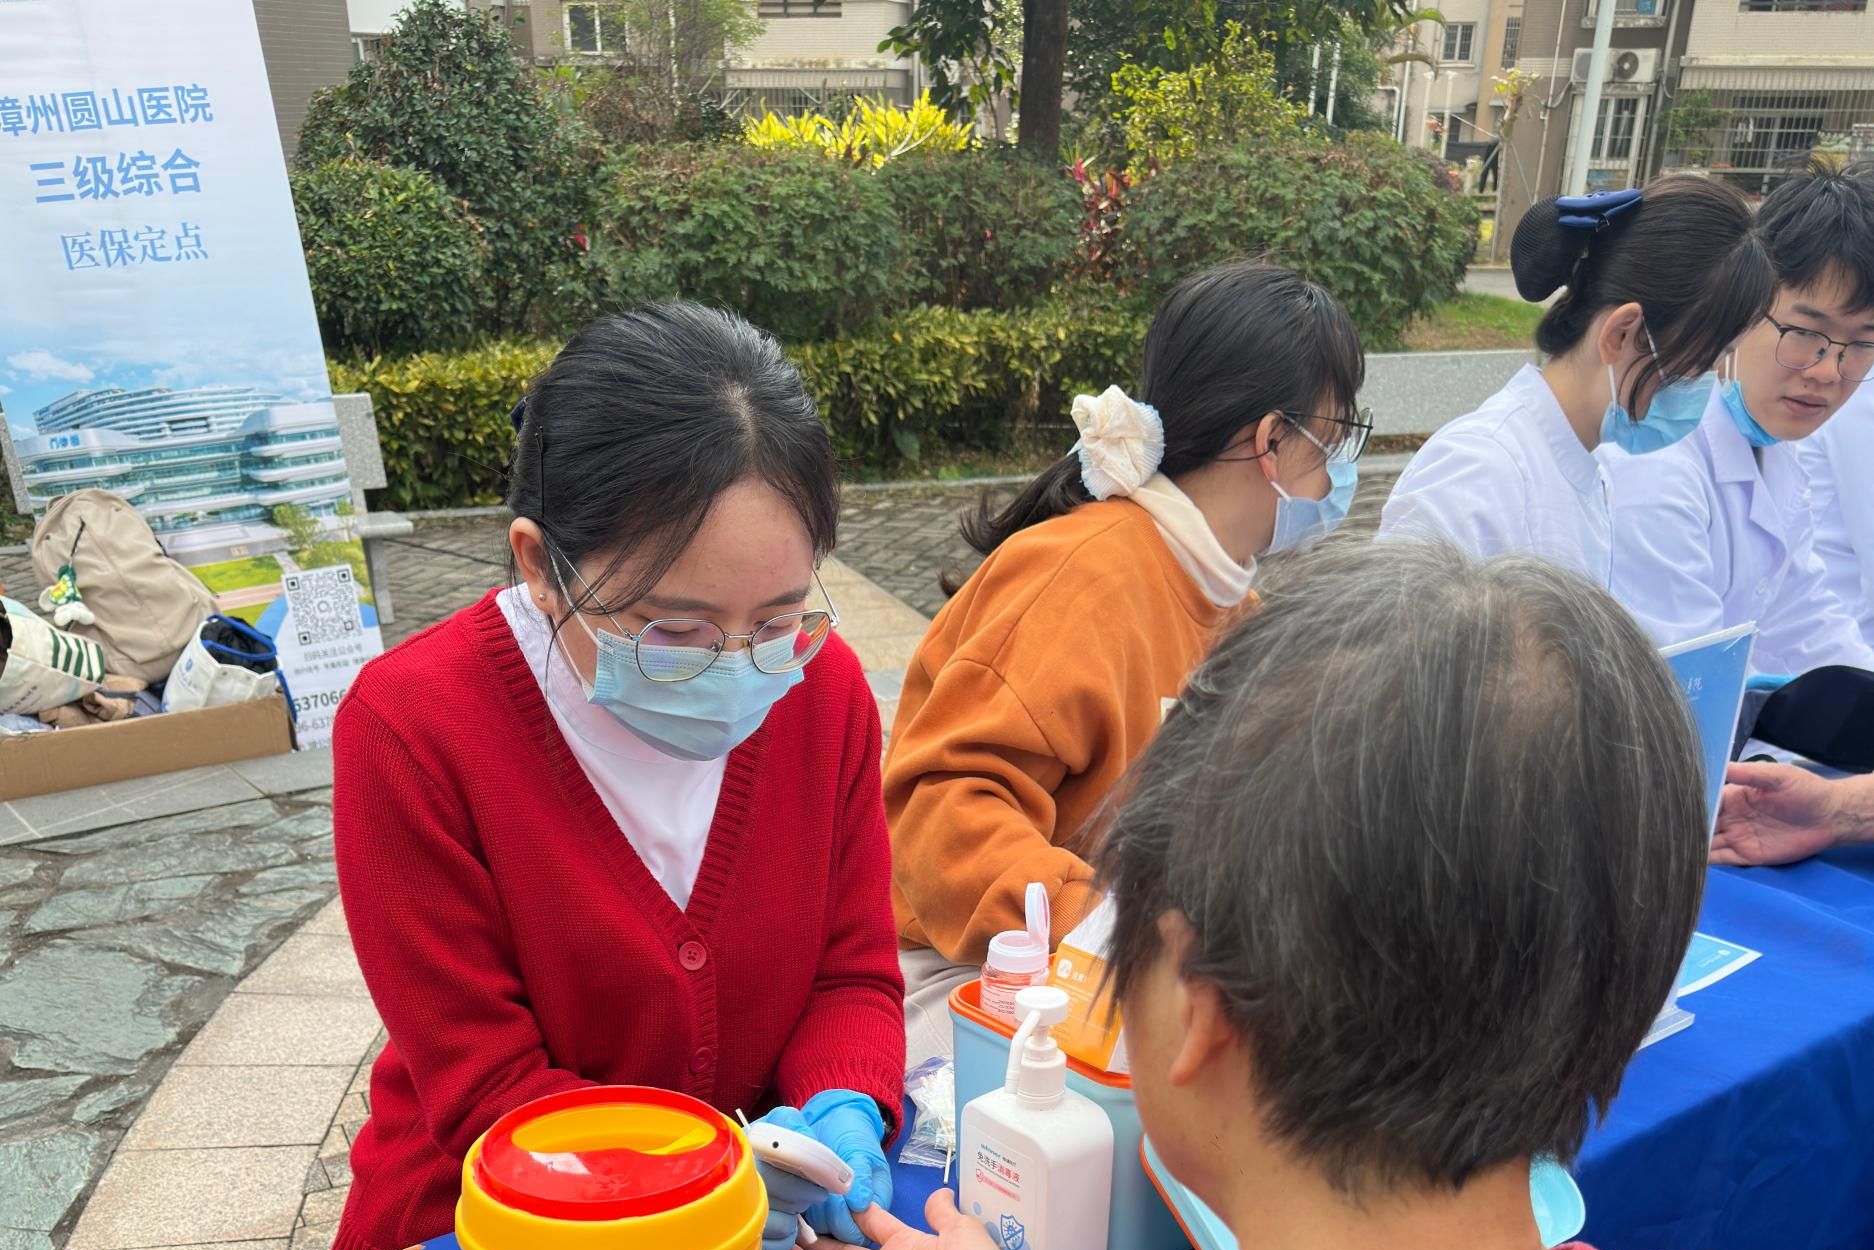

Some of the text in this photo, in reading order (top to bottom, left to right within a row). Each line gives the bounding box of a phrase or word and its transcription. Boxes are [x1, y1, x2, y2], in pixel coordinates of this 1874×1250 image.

[0, 84, 214, 136] 漳州圆山医院
[30, 148, 201, 203] 三级综合
[60, 222, 209, 271] 医保定点
